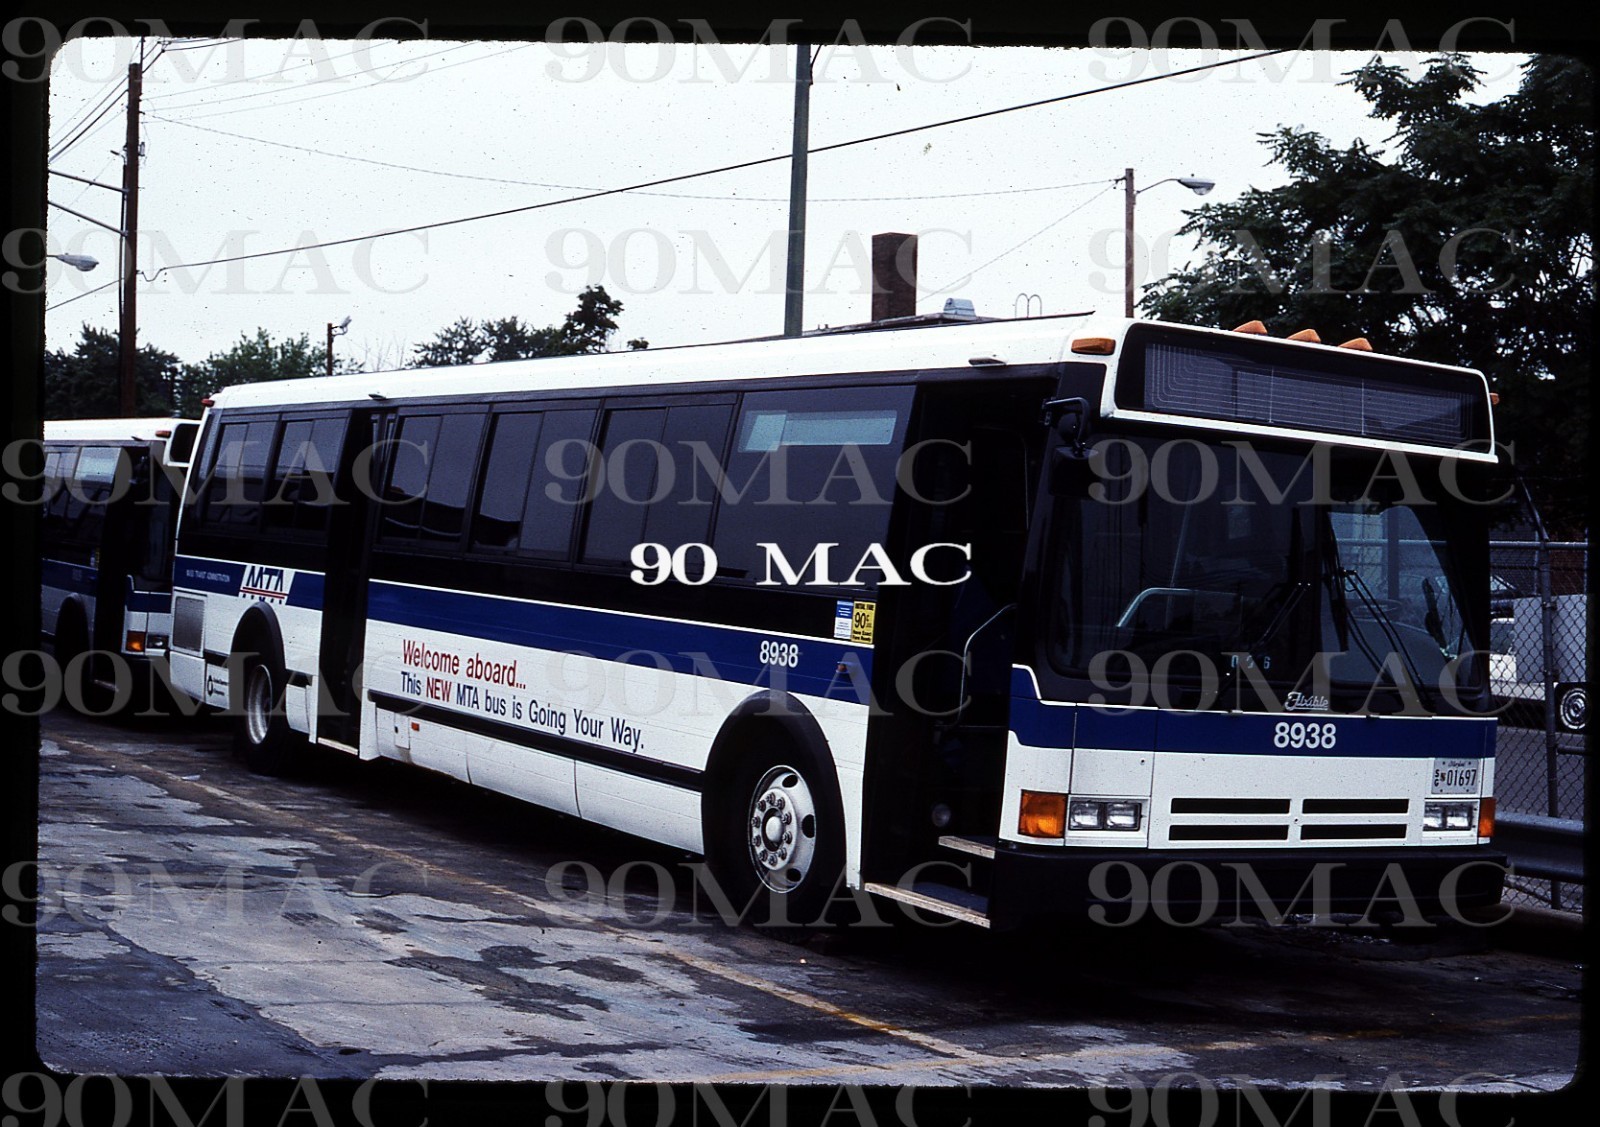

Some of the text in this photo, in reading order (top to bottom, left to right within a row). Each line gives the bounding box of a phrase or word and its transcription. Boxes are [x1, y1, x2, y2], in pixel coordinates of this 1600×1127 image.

[246, 565, 285, 592] MTA
[403, 639, 526, 690] Welcome aboard...
[759, 640, 799, 668] 8938
[401, 671, 644, 753] This NEW MTA bus is Going Your Way.
[1273, 721, 1337, 749] 8938
[1447, 769, 1477, 786] 01697
